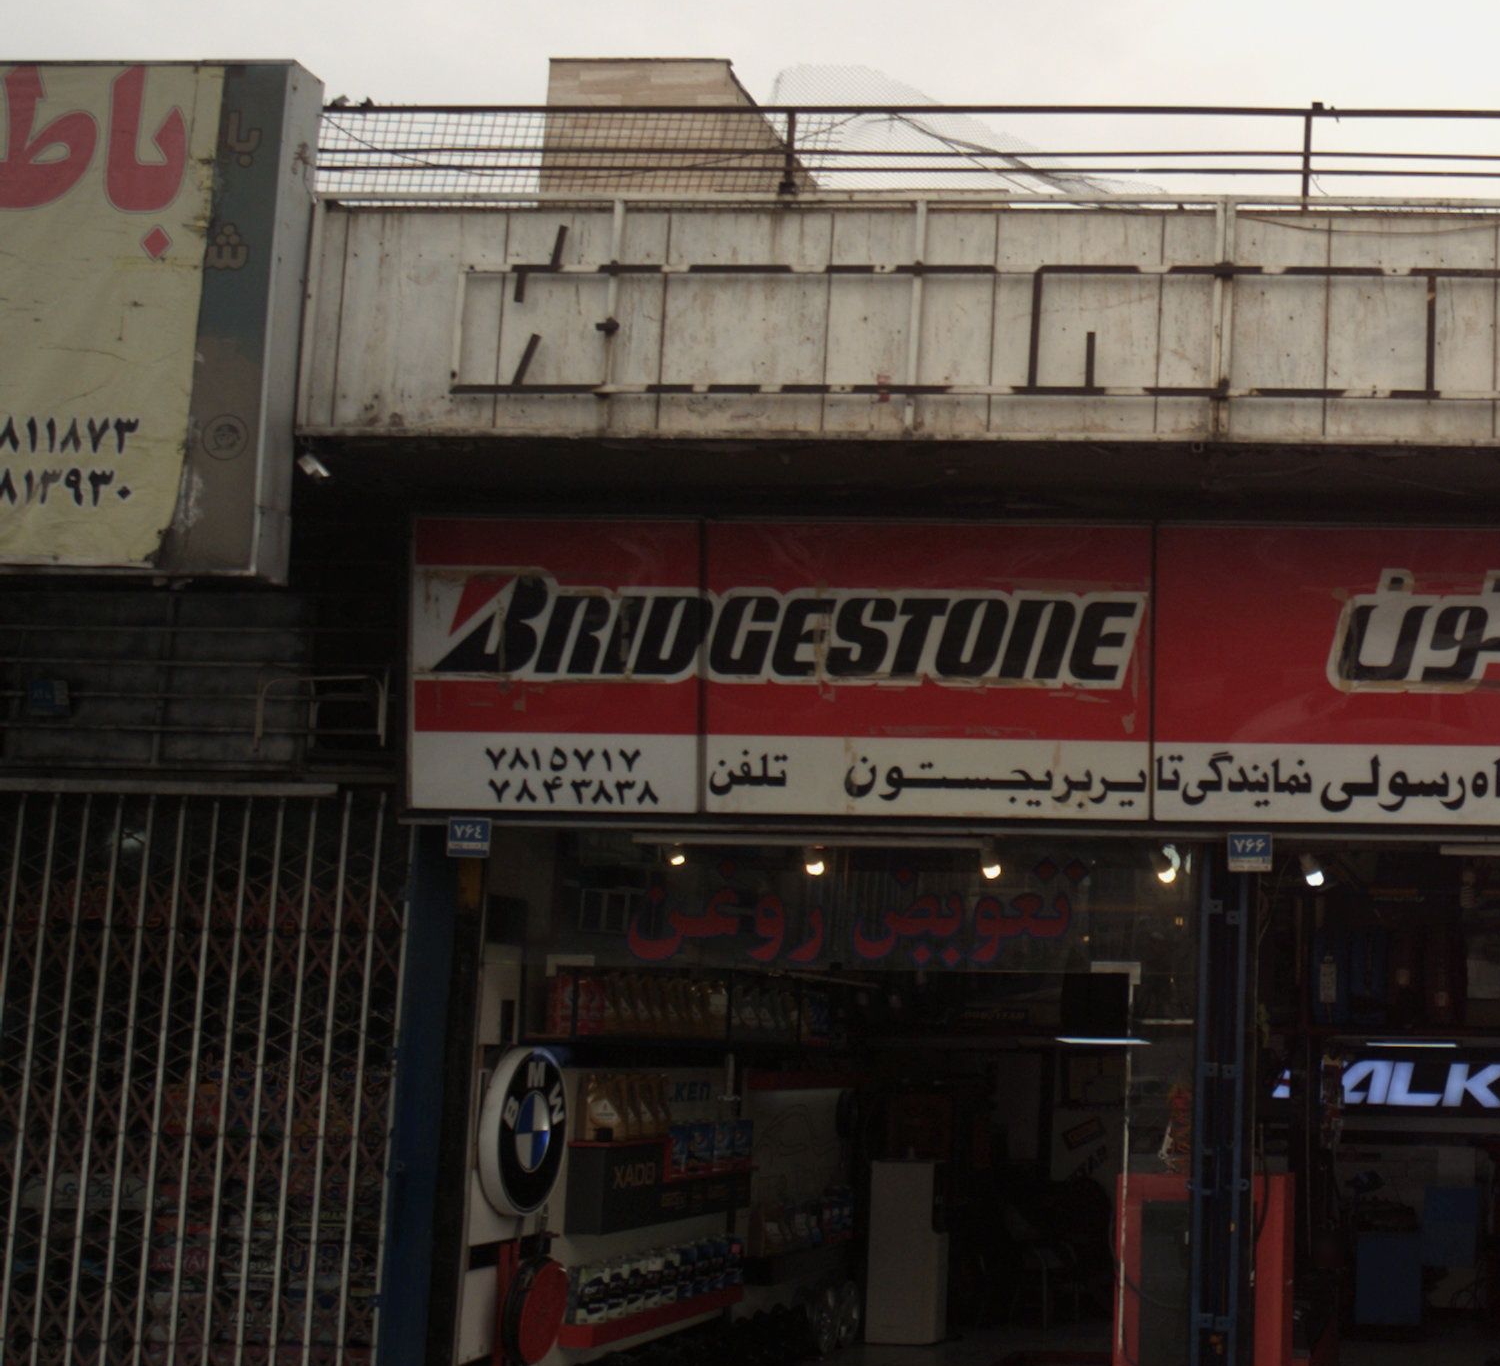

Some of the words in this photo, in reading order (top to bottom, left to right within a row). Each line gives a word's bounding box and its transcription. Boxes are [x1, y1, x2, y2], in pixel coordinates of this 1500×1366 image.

[431, 573, 1139, 682] BRIDGESTONE
[485, 746, 641, 772] ۷۸۱۵۷۱۷
[708, 748, 789, 796] تلفن
[1181, 750, 1313, 809] نمایندگی
[1320, 753, 1466, 812] رسولی
[488, 776, 659, 805] ۷۸۴۳۸۳۸
[1233, 838, 1266, 854] ۷۶۶
[626, 857, 826, 963] روغن
[853, 856, 1093, 967] تعویض
